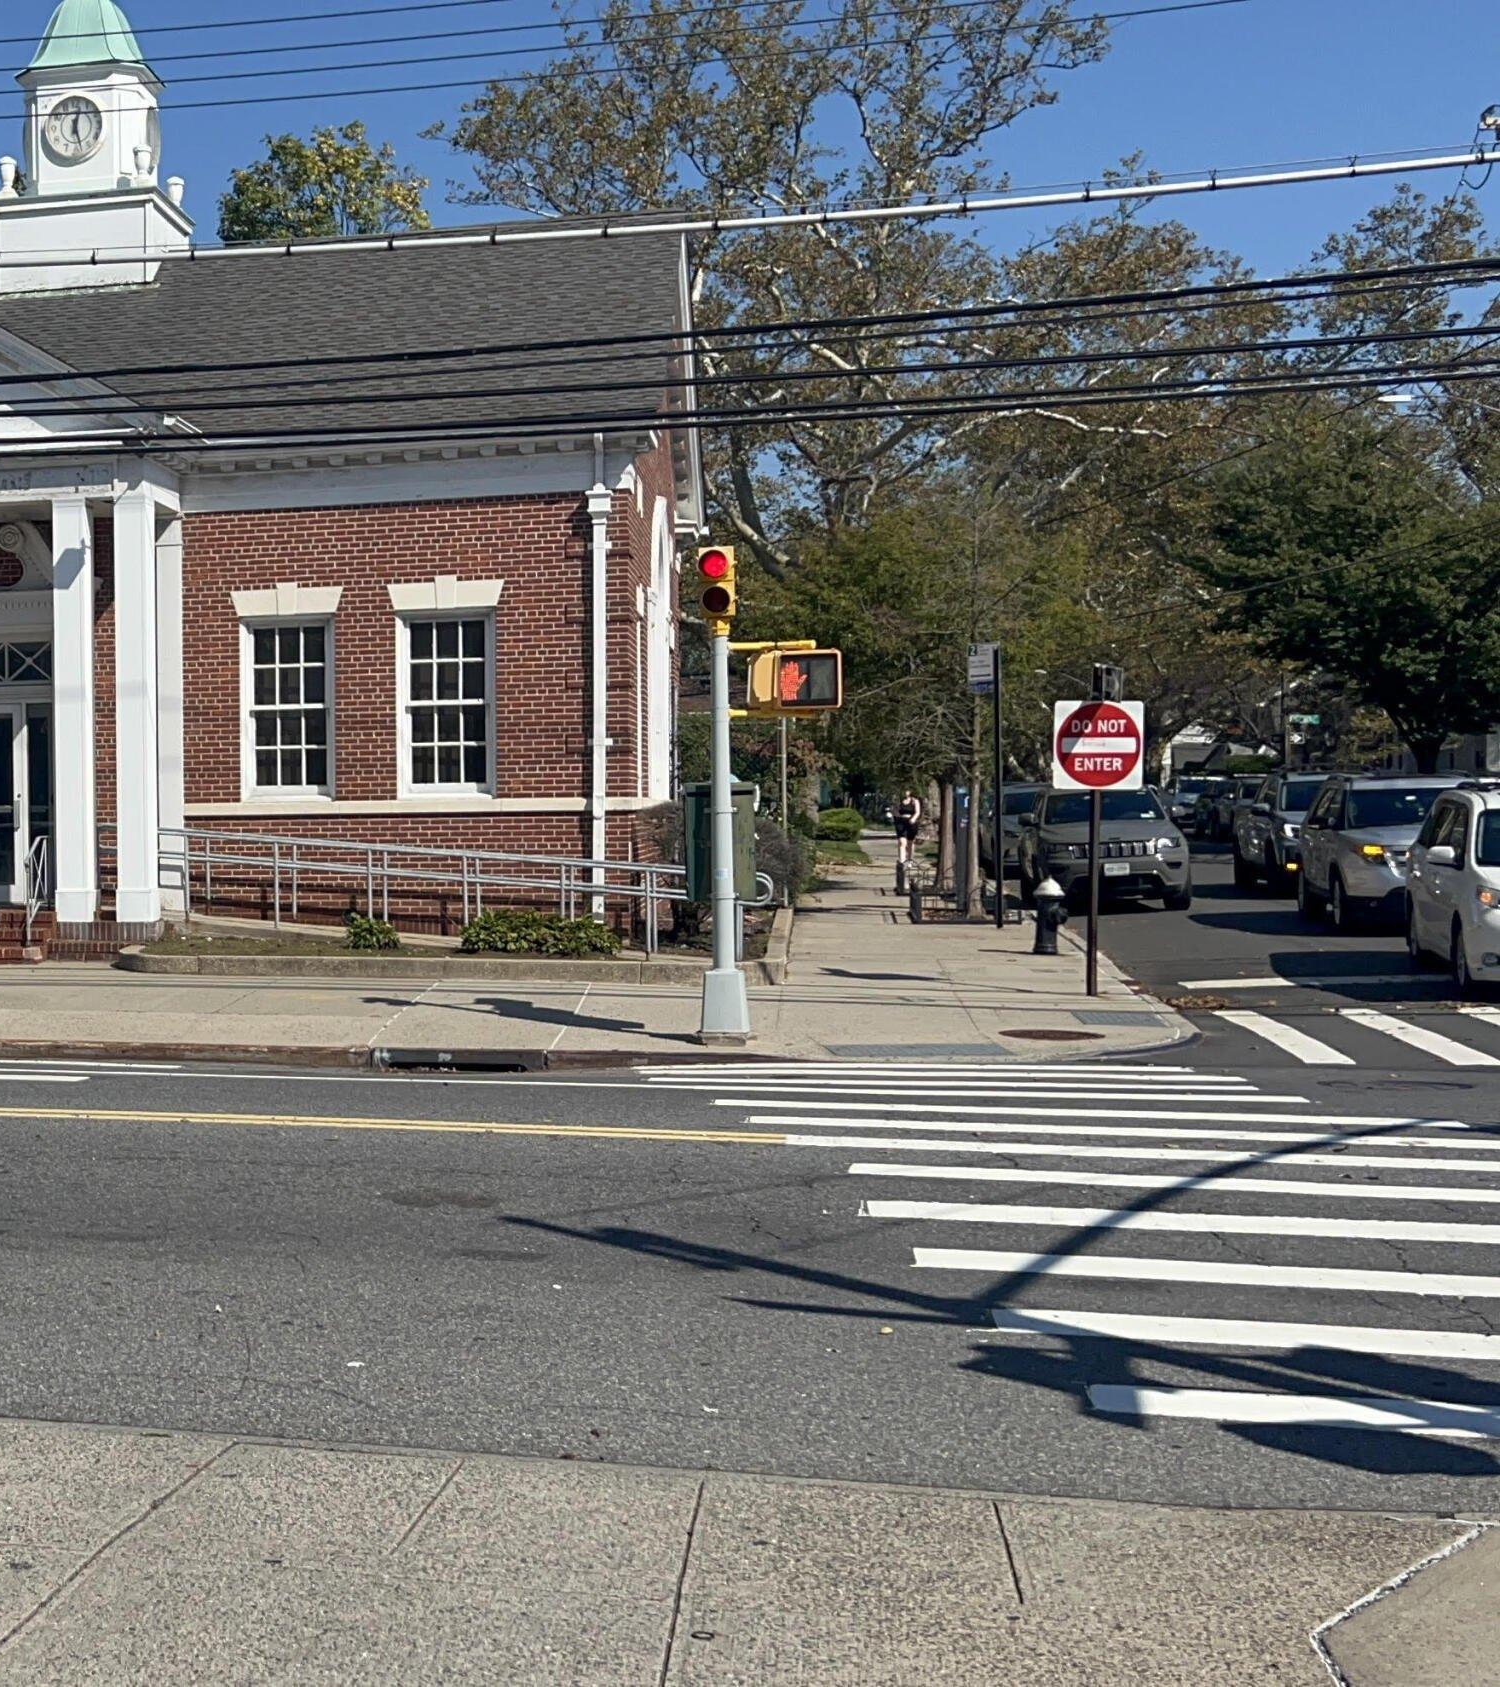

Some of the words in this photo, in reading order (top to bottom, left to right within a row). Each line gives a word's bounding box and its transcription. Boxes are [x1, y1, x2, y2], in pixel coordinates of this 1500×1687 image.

[1071, 719, 1093, 733] DO
[1097, 719, 1127, 733] NOT
[1074, 757, 1123, 772] ENTER
